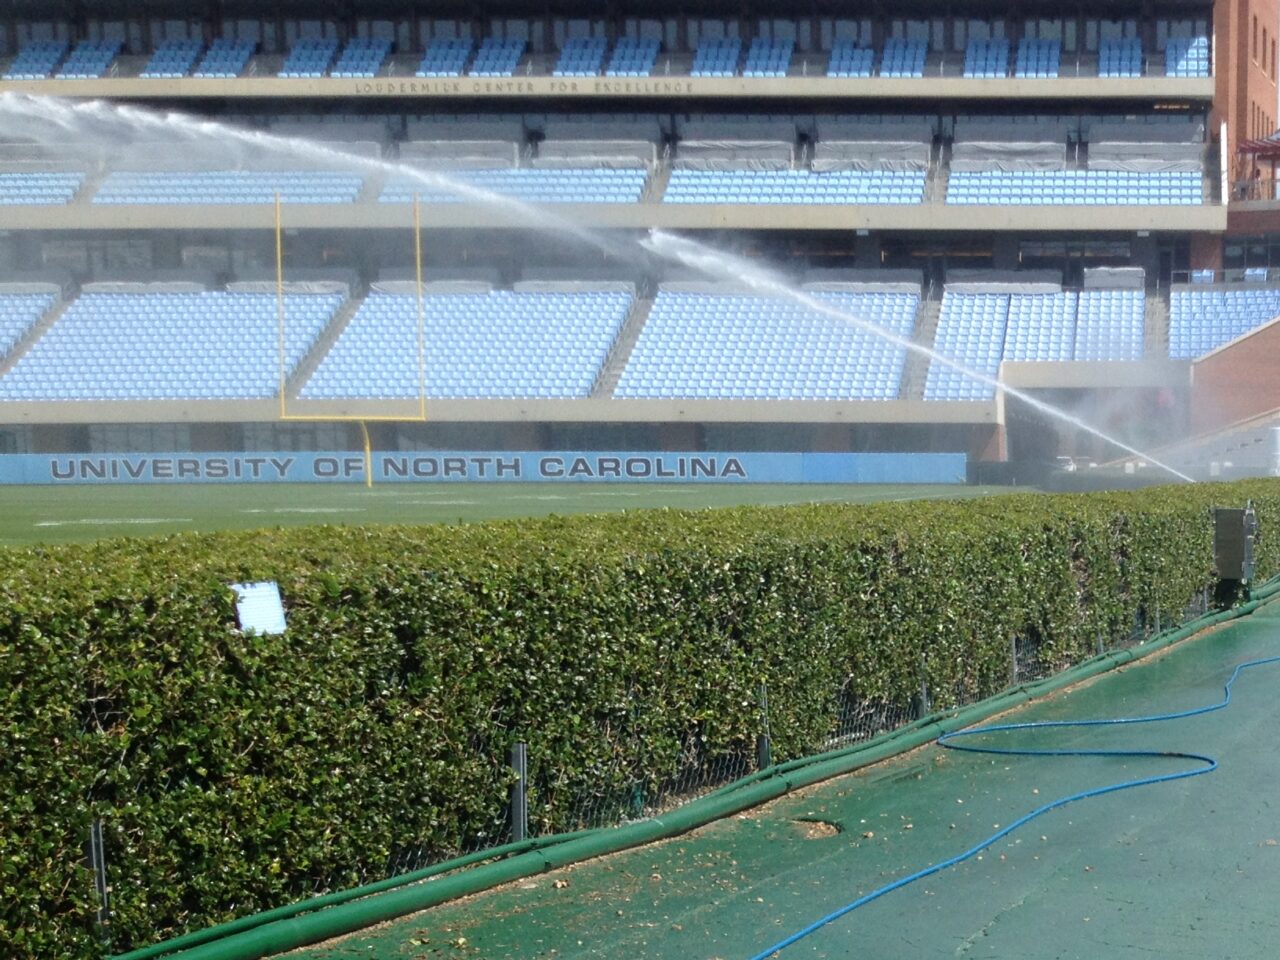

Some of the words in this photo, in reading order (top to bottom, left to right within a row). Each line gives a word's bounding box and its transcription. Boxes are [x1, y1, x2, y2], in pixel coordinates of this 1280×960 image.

[354, 83, 460, 93] LOUDERMILK
[468, 83, 534, 93] CENTER
[550, 83, 578, 92] FOR
[595, 83, 693, 93] EXCELLENCE
[51, 457, 294, 479] UNIVERSITY
[312, 457, 364, 478] OF
[382, 457, 522, 478] NORTH
[539, 457, 748, 478] CAROLINA
